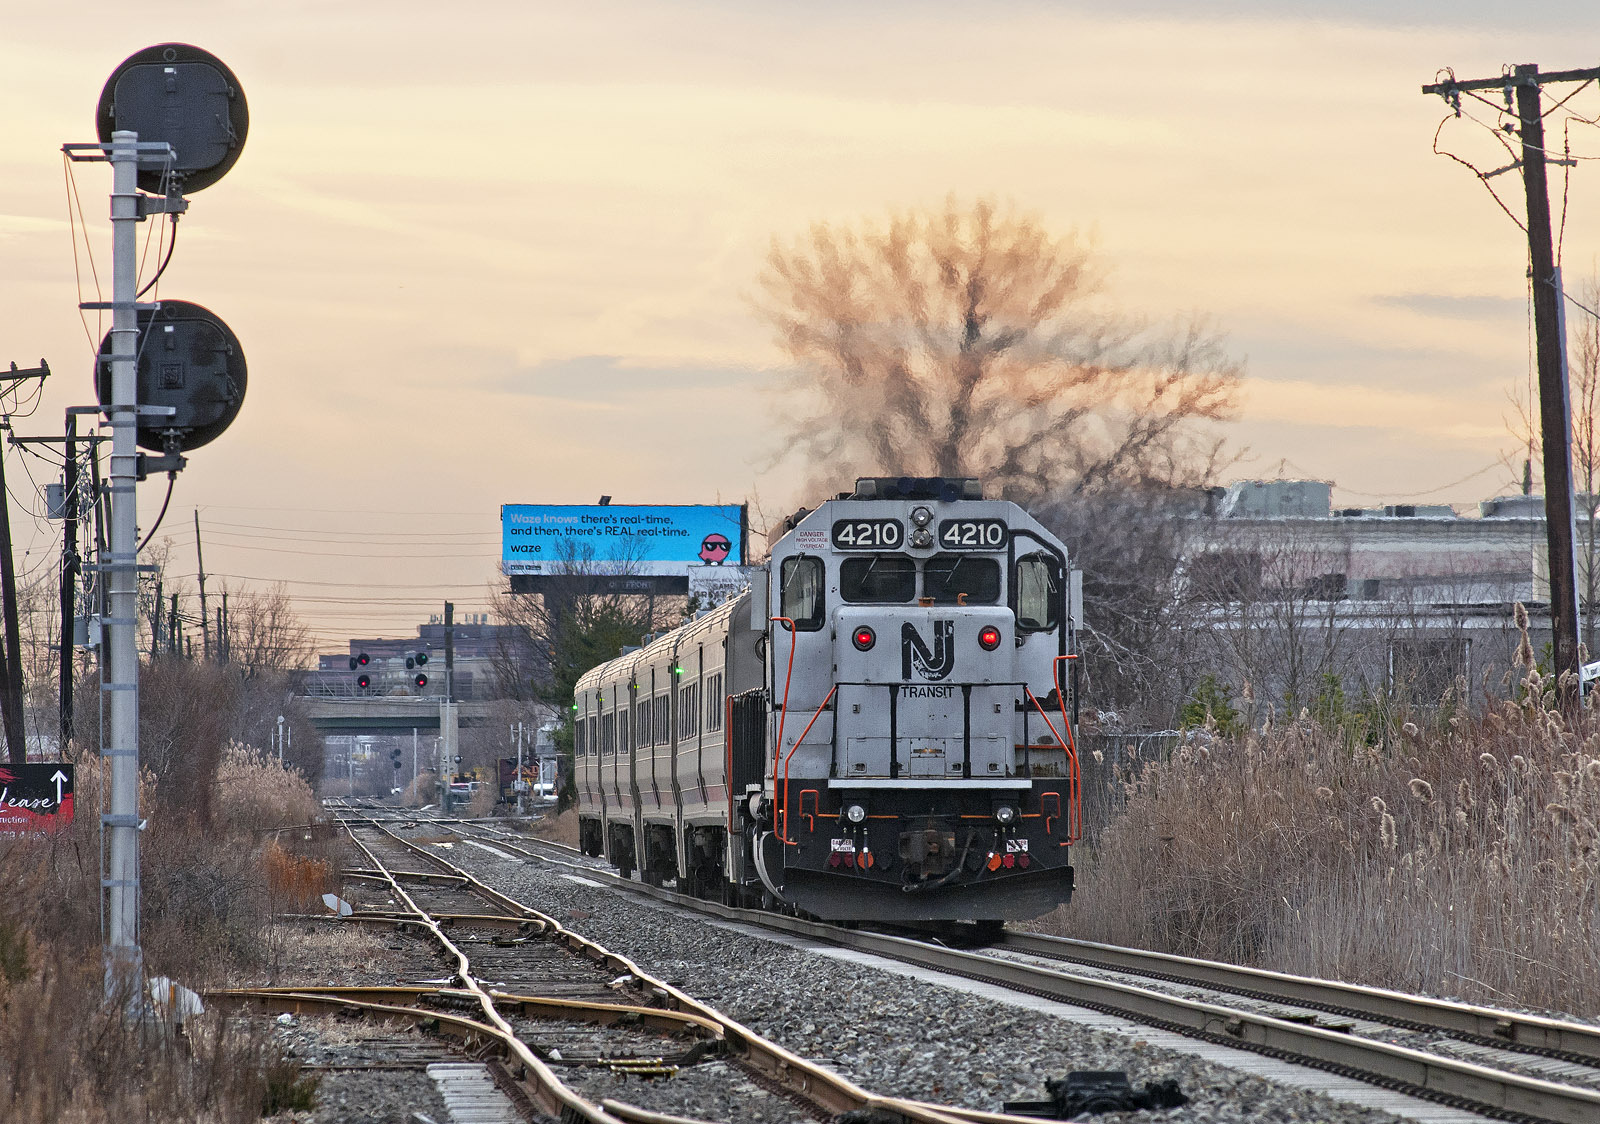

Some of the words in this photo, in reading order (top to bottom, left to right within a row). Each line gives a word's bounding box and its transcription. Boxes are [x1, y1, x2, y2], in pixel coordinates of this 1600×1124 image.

[511, 513, 541, 524] Waze
[543, 513, 578, 524] knows
[581, 514, 617, 524] there's
[620, 514, 673, 525] real-time,
[511, 526, 531, 535] and
[535, 526, 562, 536] then,
[565, 526, 602, 536] there's
[605, 526, 634, 535] REAL
[637, 526, 690, 536] real-time.
[837, 523, 898, 545] 4210
[943, 523, 1003, 545] 4210
[511, 544, 541, 553] waze
[901, 620, 954, 681] NJ
[901, 686, 954, 698] TRANSIT
